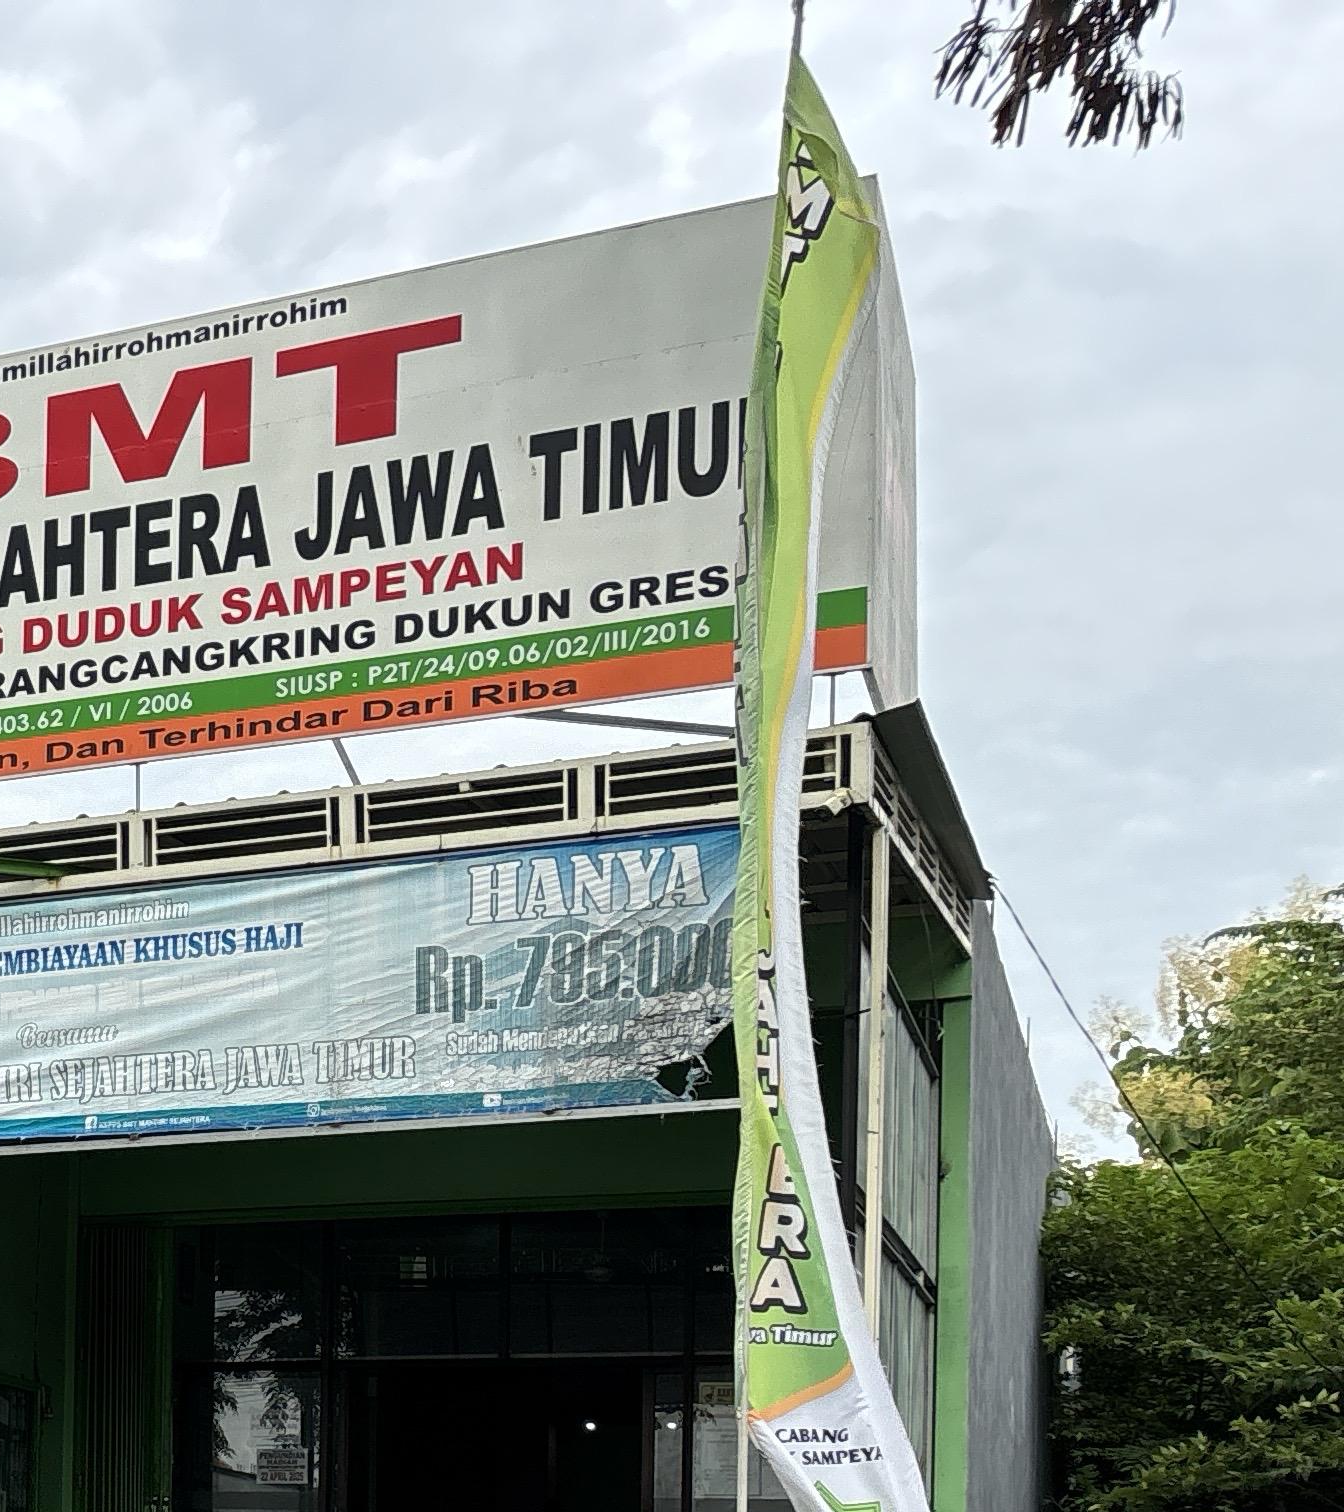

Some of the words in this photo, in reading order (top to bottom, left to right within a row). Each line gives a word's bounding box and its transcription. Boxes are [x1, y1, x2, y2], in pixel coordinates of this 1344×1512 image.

[294, 443, 506, 562] JAWA
[528, 396, 748, 522] TIMU
[21, 592, 204, 656] DUDUK
[220, 541, 524, 626] SAMPEYAN
[394, 586, 572, 644] DUKUN
[588, 564, 730, 613] GRES
[45, 734, 125, 764] Dan
[138, 705, 350, 751] Terhindar
[362, 690, 453, 721] Dari
[472, 674, 578, 707] Riba
[89, 701, 112, 721] VI
[137, 691, 194, 716] 2006
[275, 672, 346, 698] SIUSP
[466, 843, 711, 926] HANYA
[133, 927, 237, 974] KHUSUS
[244, 922, 304, 955] HAJI
[415, 944, 500, 1024] Rp.
[15, 1021, 120, 1050] Bersama
[447, 1029, 499, 1056] Sudah
[48, 1048, 218, 1105] SEJAHTERA
[224, 1040, 304, 1095] JAWA
[314, 1036, 417, 1084] TIMUR
[770, 1325, 839, 1347] Timur
[775, 1428, 849, 1443] CABANG
[802, 1446, 884, 1465] SAMPEYA
